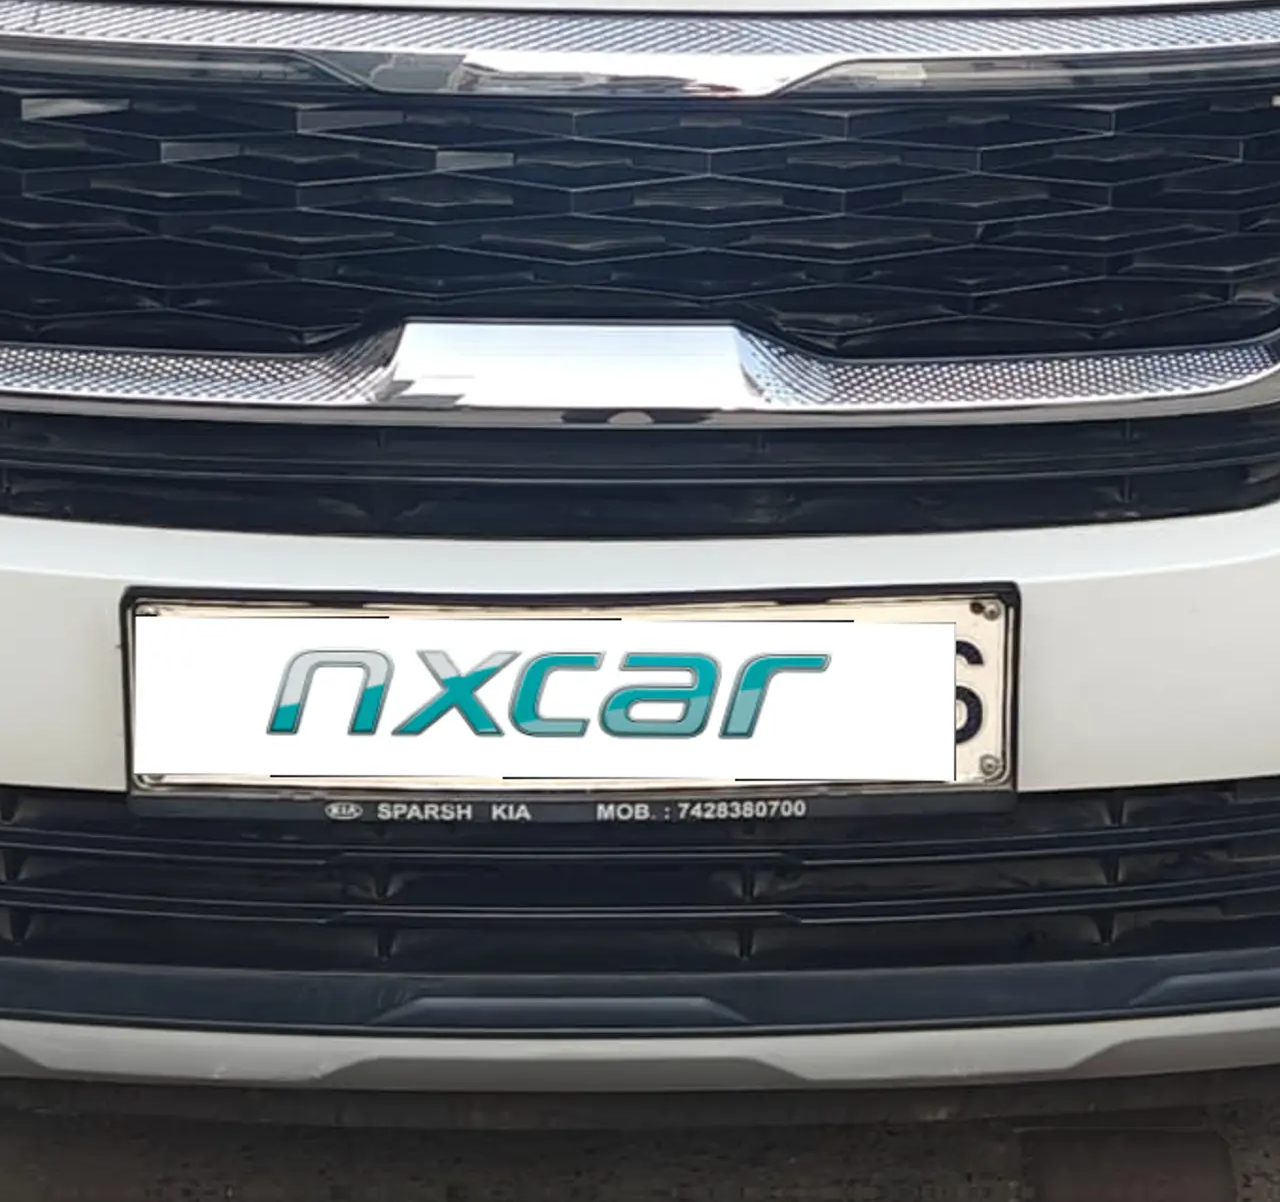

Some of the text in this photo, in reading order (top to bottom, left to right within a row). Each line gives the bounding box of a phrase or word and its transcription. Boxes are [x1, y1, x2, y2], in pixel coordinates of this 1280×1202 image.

[377, 803, 472, 821] SPARSH
[492, 803, 532, 821] KIA
[677, 800, 807, 820] 7428380700
